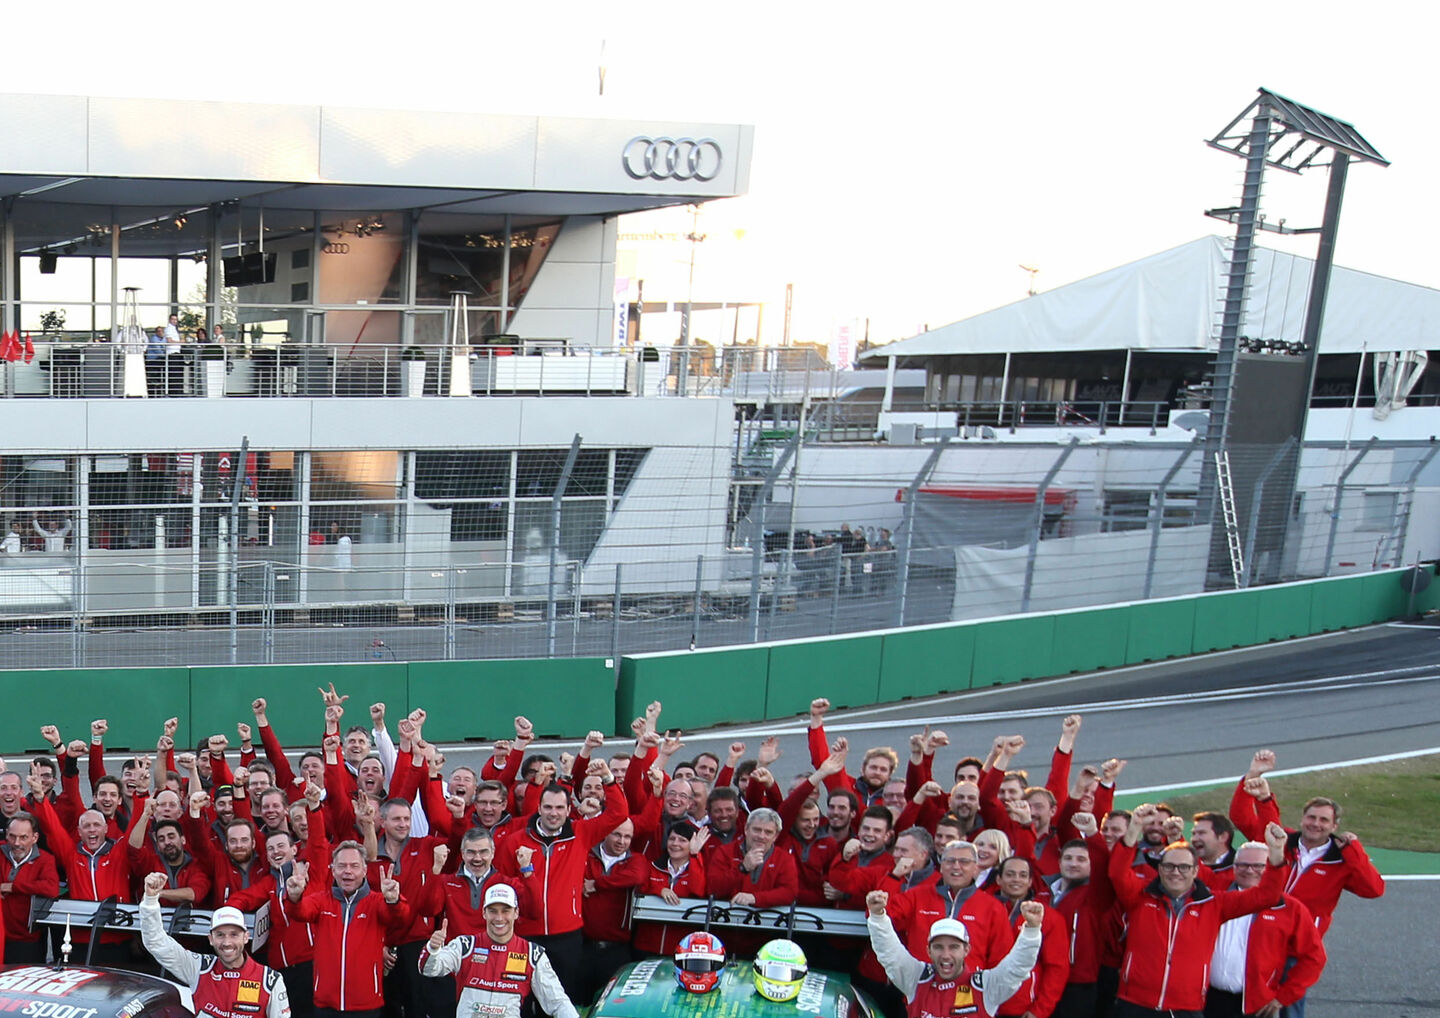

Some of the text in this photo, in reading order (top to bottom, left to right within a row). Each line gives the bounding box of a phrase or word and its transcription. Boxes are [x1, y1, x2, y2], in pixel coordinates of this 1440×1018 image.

[509, 952, 528, 961] ADAC
[240, 981, 260, 990] ADAC
[479, 978, 519, 991] Audi Sport
[123, 998, 145, 1017] RAST
[212, 1006, 231, 1018] Audi
[479, 1003, 505, 1014] Castrol
